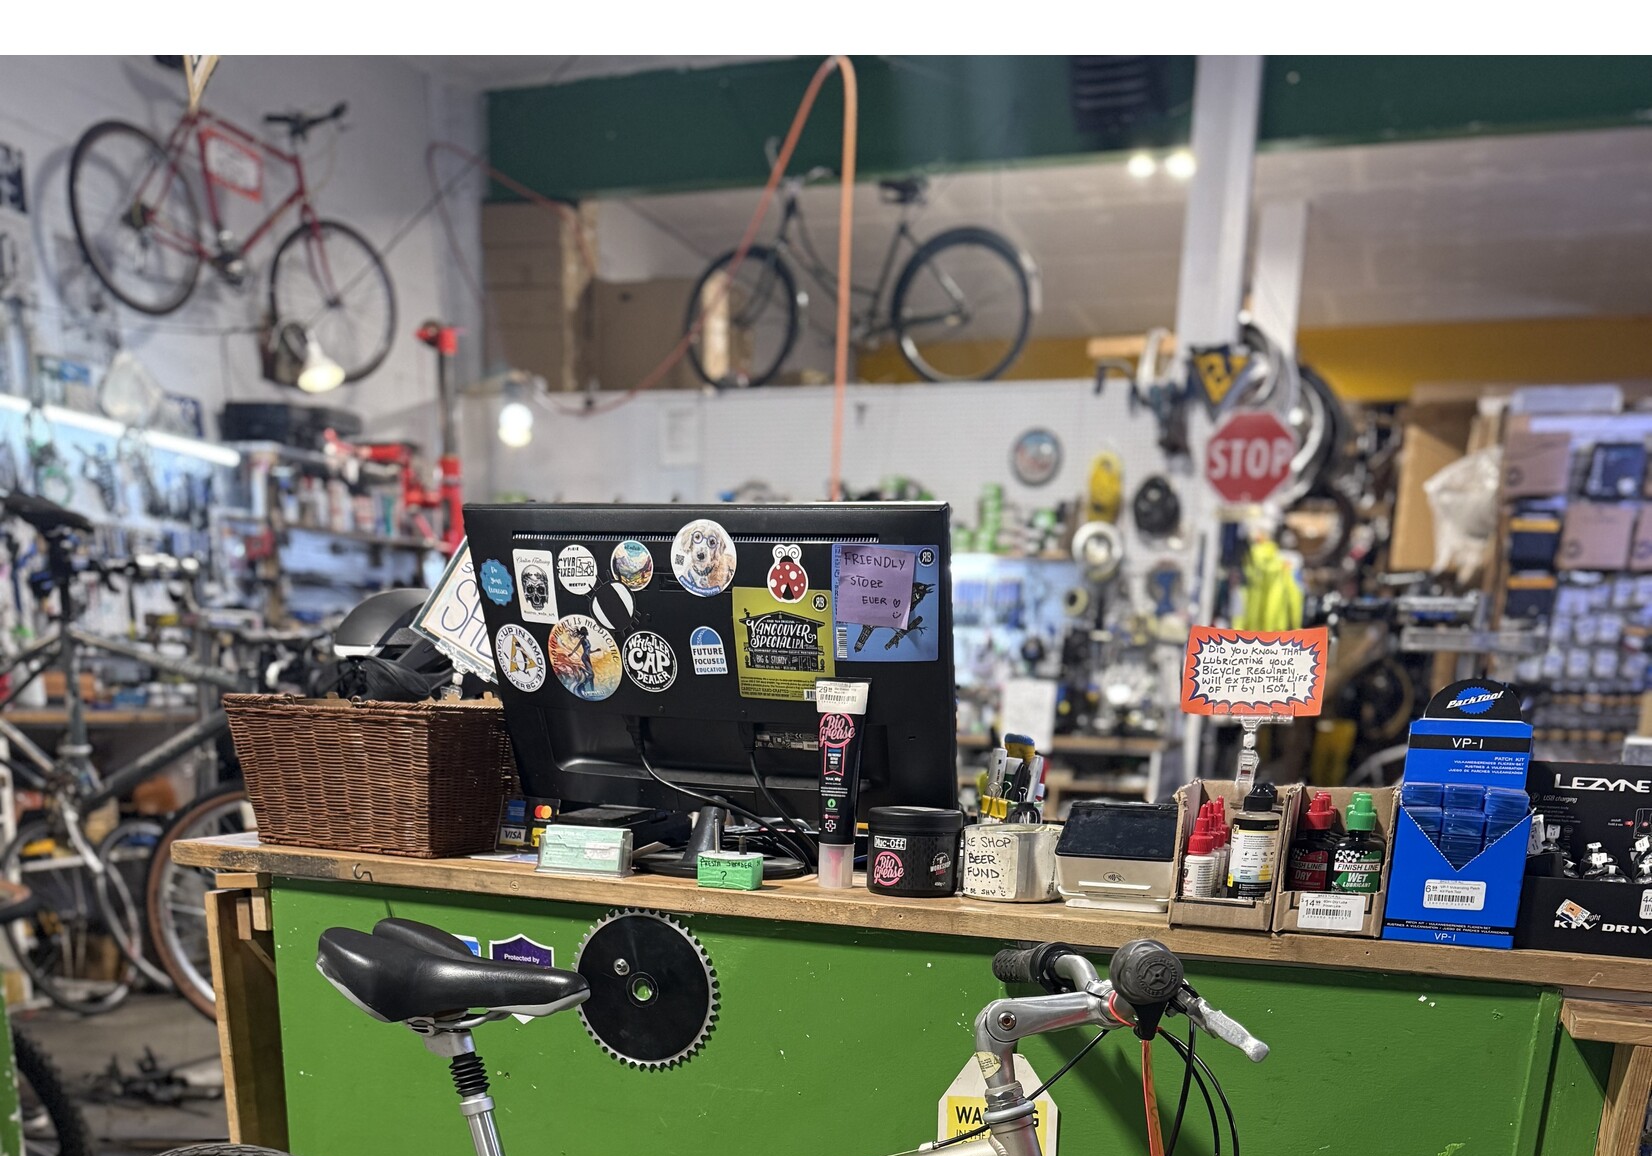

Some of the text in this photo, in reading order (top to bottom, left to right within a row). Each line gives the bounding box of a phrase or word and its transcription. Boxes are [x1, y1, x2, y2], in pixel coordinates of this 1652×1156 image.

[1209, 438, 1294, 479] STOP
[844, 552, 905, 570] FRIENDLY
[850, 575, 884, 588] STORE
[746, 616, 817, 643] VANCOUVER
[628, 634, 671, 659] WHISTLER
[751, 635, 792, 648] SPECIAL
[503, 627, 545, 685] UP IN SMOKE
[692, 648, 723, 656] FUTURE
[1251, 647, 1278, 655] KNOW
[1281, 647, 1302, 656] THAT
[628, 647, 671, 674] CAP
[637, 670, 671, 685] DEALER
[1202, 665, 1241, 679] Bicycle
[1266, 675, 1285, 684] THE
[1208, 686, 1222, 694] OF
[1227, 685, 1238, 693] IT
[826, 714, 846, 729] Bio
[819, 726, 856, 748] Grease
[1452, 738, 1484, 749] VP-1
[1554, 773, 1652, 793] LEZYNE
[504, 830, 523, 840] VISA
[875, 837, 904, 849] Muc-Off
[980, 836, 1011, 848] SHOP
[879, 855, 895, 870] Bio
[969, 852, 996, 865] BEER
[967, 867, 1000, 879] FUND
[1337, 863, 1364, 871] FINISH
[874, 865, 905, 885] Grease
[1295, 870, 1312, 880] DRY
[1347, 872, 1369, 883] WET
[1426, 885, 1431, 893] 6
[1434, 932, 1456, 942] VP-1
[504, 953, 540, 965] Protected by
